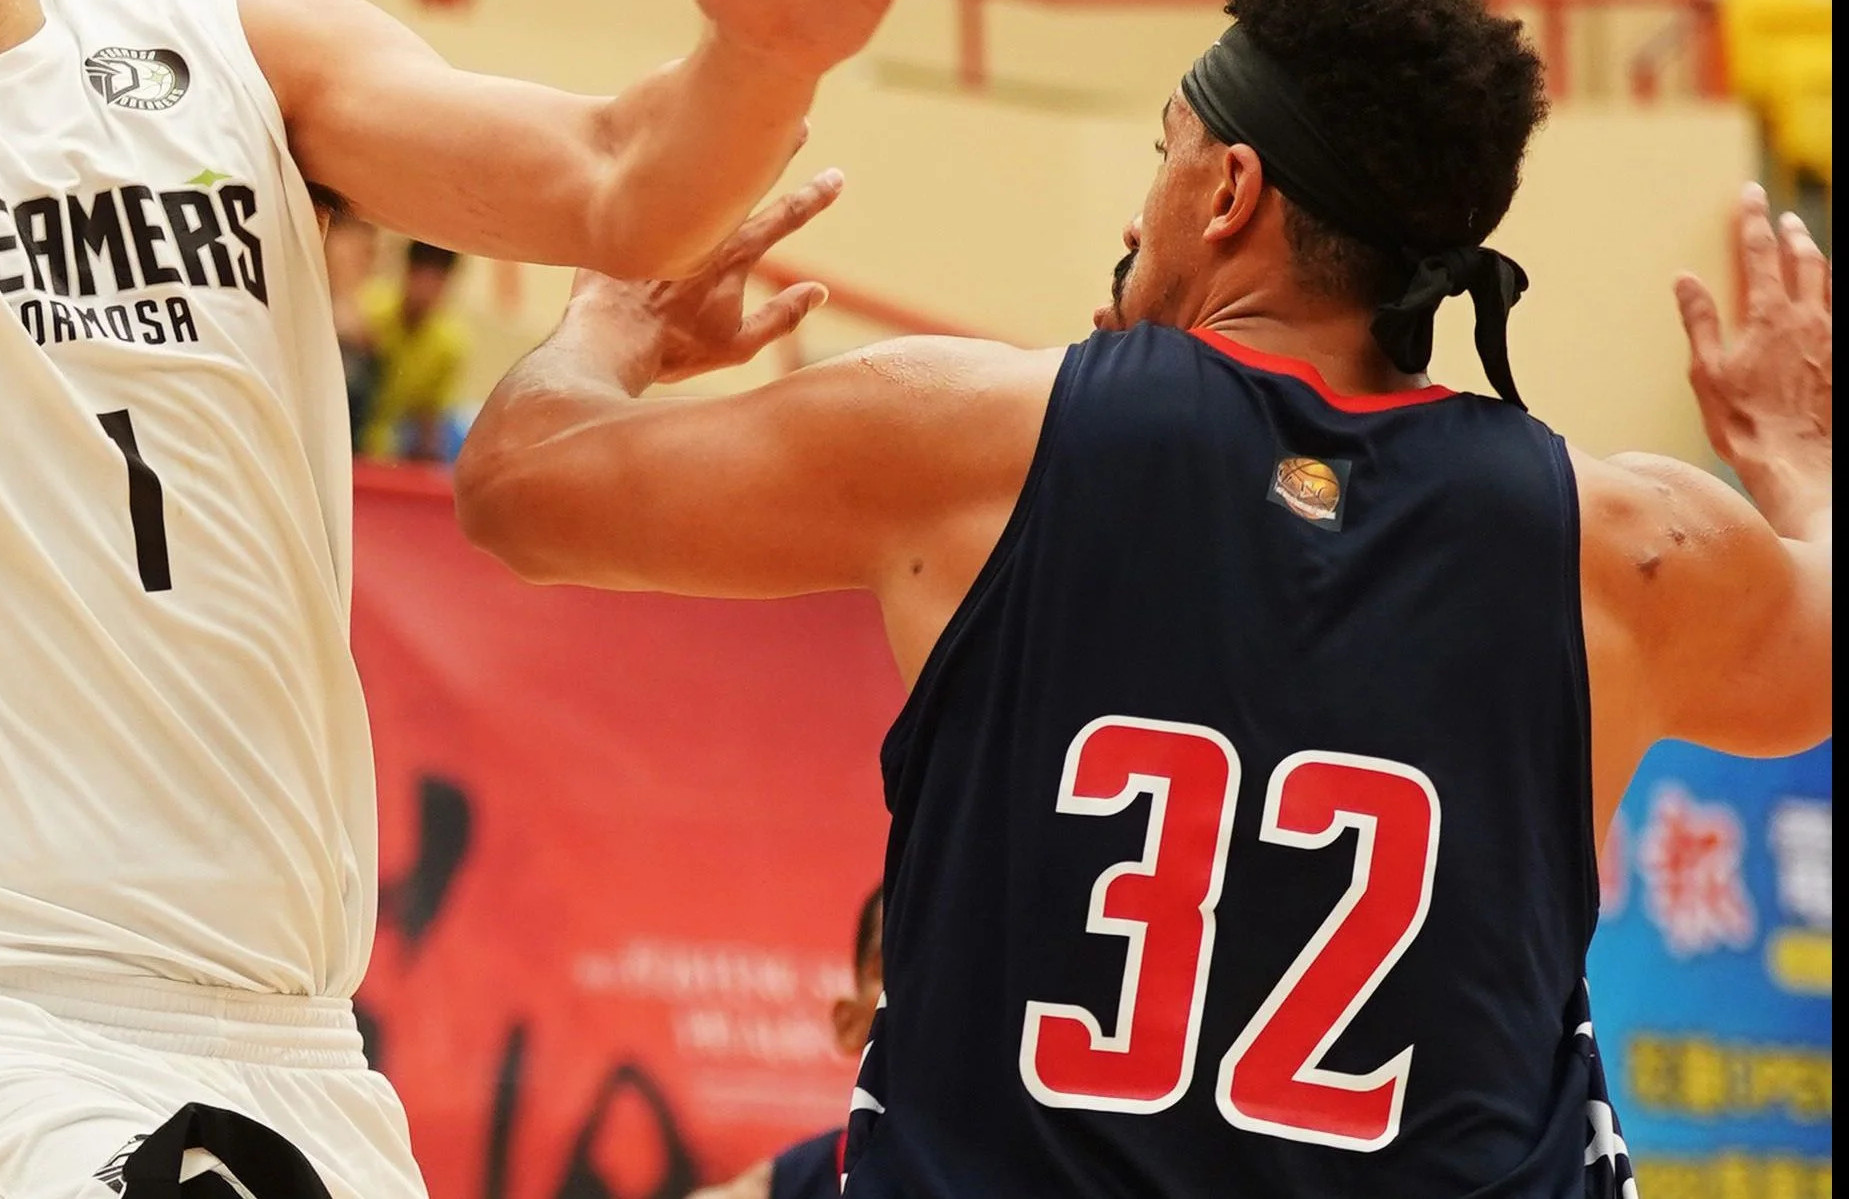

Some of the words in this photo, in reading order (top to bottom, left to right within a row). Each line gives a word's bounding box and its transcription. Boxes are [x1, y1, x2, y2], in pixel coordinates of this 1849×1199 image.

[20, 296, 199, 347] ORMOSA
[96, 409, 172, 593] 1
[1019, 714, 1442, 1152] 32
